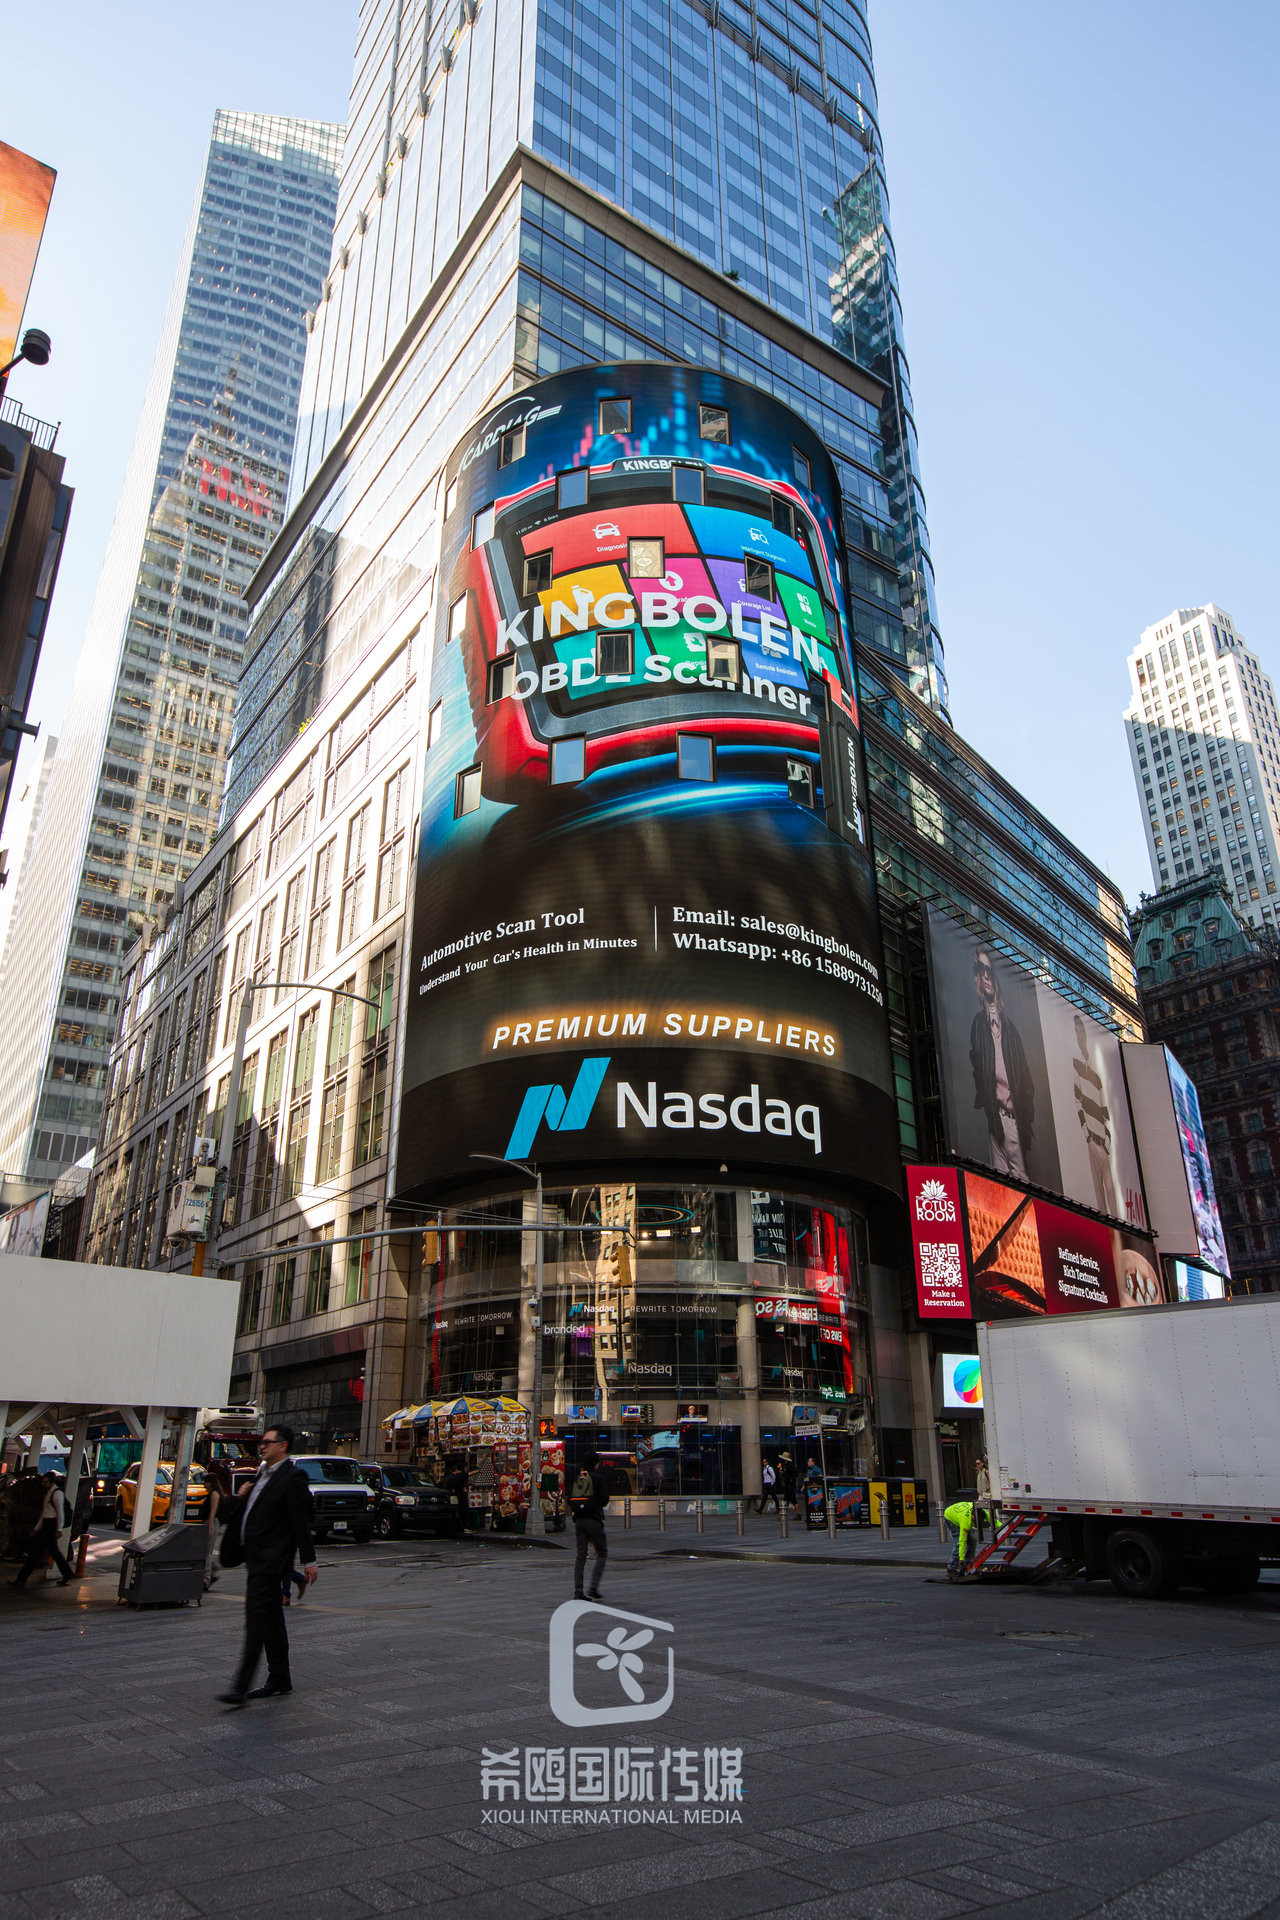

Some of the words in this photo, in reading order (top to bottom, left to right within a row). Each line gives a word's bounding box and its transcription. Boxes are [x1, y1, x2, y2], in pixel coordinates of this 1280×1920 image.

[623, 460, 703, 471] KINGB
[496, 592, 821, 673] KINGBOLEN
[511, 655, 631, 701] OBD
[421, 929, 492, 972] Automotive
[496, 919, 536, 938] Scan
[541, 908, 584, 928] Tool
[672, 906, 735, 926] Email:
[740, 916, 879, 980] sales@kingbolen.com
[673, 932, 777, 962] Whatsapp:
[781, 949, 811, 968] +86
[419, 966, 461, 996] Understand
[464, 959, 488, 973] Your
[493, 949, 520, 964] Car's
[523, 942, 564, 958] Health
[567, 941, 580, 951] in
[583, 937, 638, 950] Minutes
[492, 1013, 647, 1049] PREMIUM
[663, 1013, 836, 1056] SUPPLIERS
[616, 1081, 822, 1155] Nasdaq
[915, 1199, 955, 1213] LOTUS
[917, 1208, 956, 1222] ROOM
[1058, 1247, 1079, 1265] Refined
[1079, 1254, 1100, 1272] Service,
[1062, 1264, 1076, 1279] Rich
[1076, 1268, 1100, 1287] Textures,
[924, 1299, 965, 1307] Reservation
[931, 1290, 952, 1298] Make
[1058, 1280, 1085, 1298] Signature
[1085, 1288, 1108, 1304] Cocktails
[478, 1311, 513, 1322] TOMORROW
[584, 1305, 614, 1314] Nasdaq
[671, 1306, 718, 1314] TOMORROW
[544, 1324, 585, 1334] branded
[628, 1362, 672, 1376] Nasdaq
